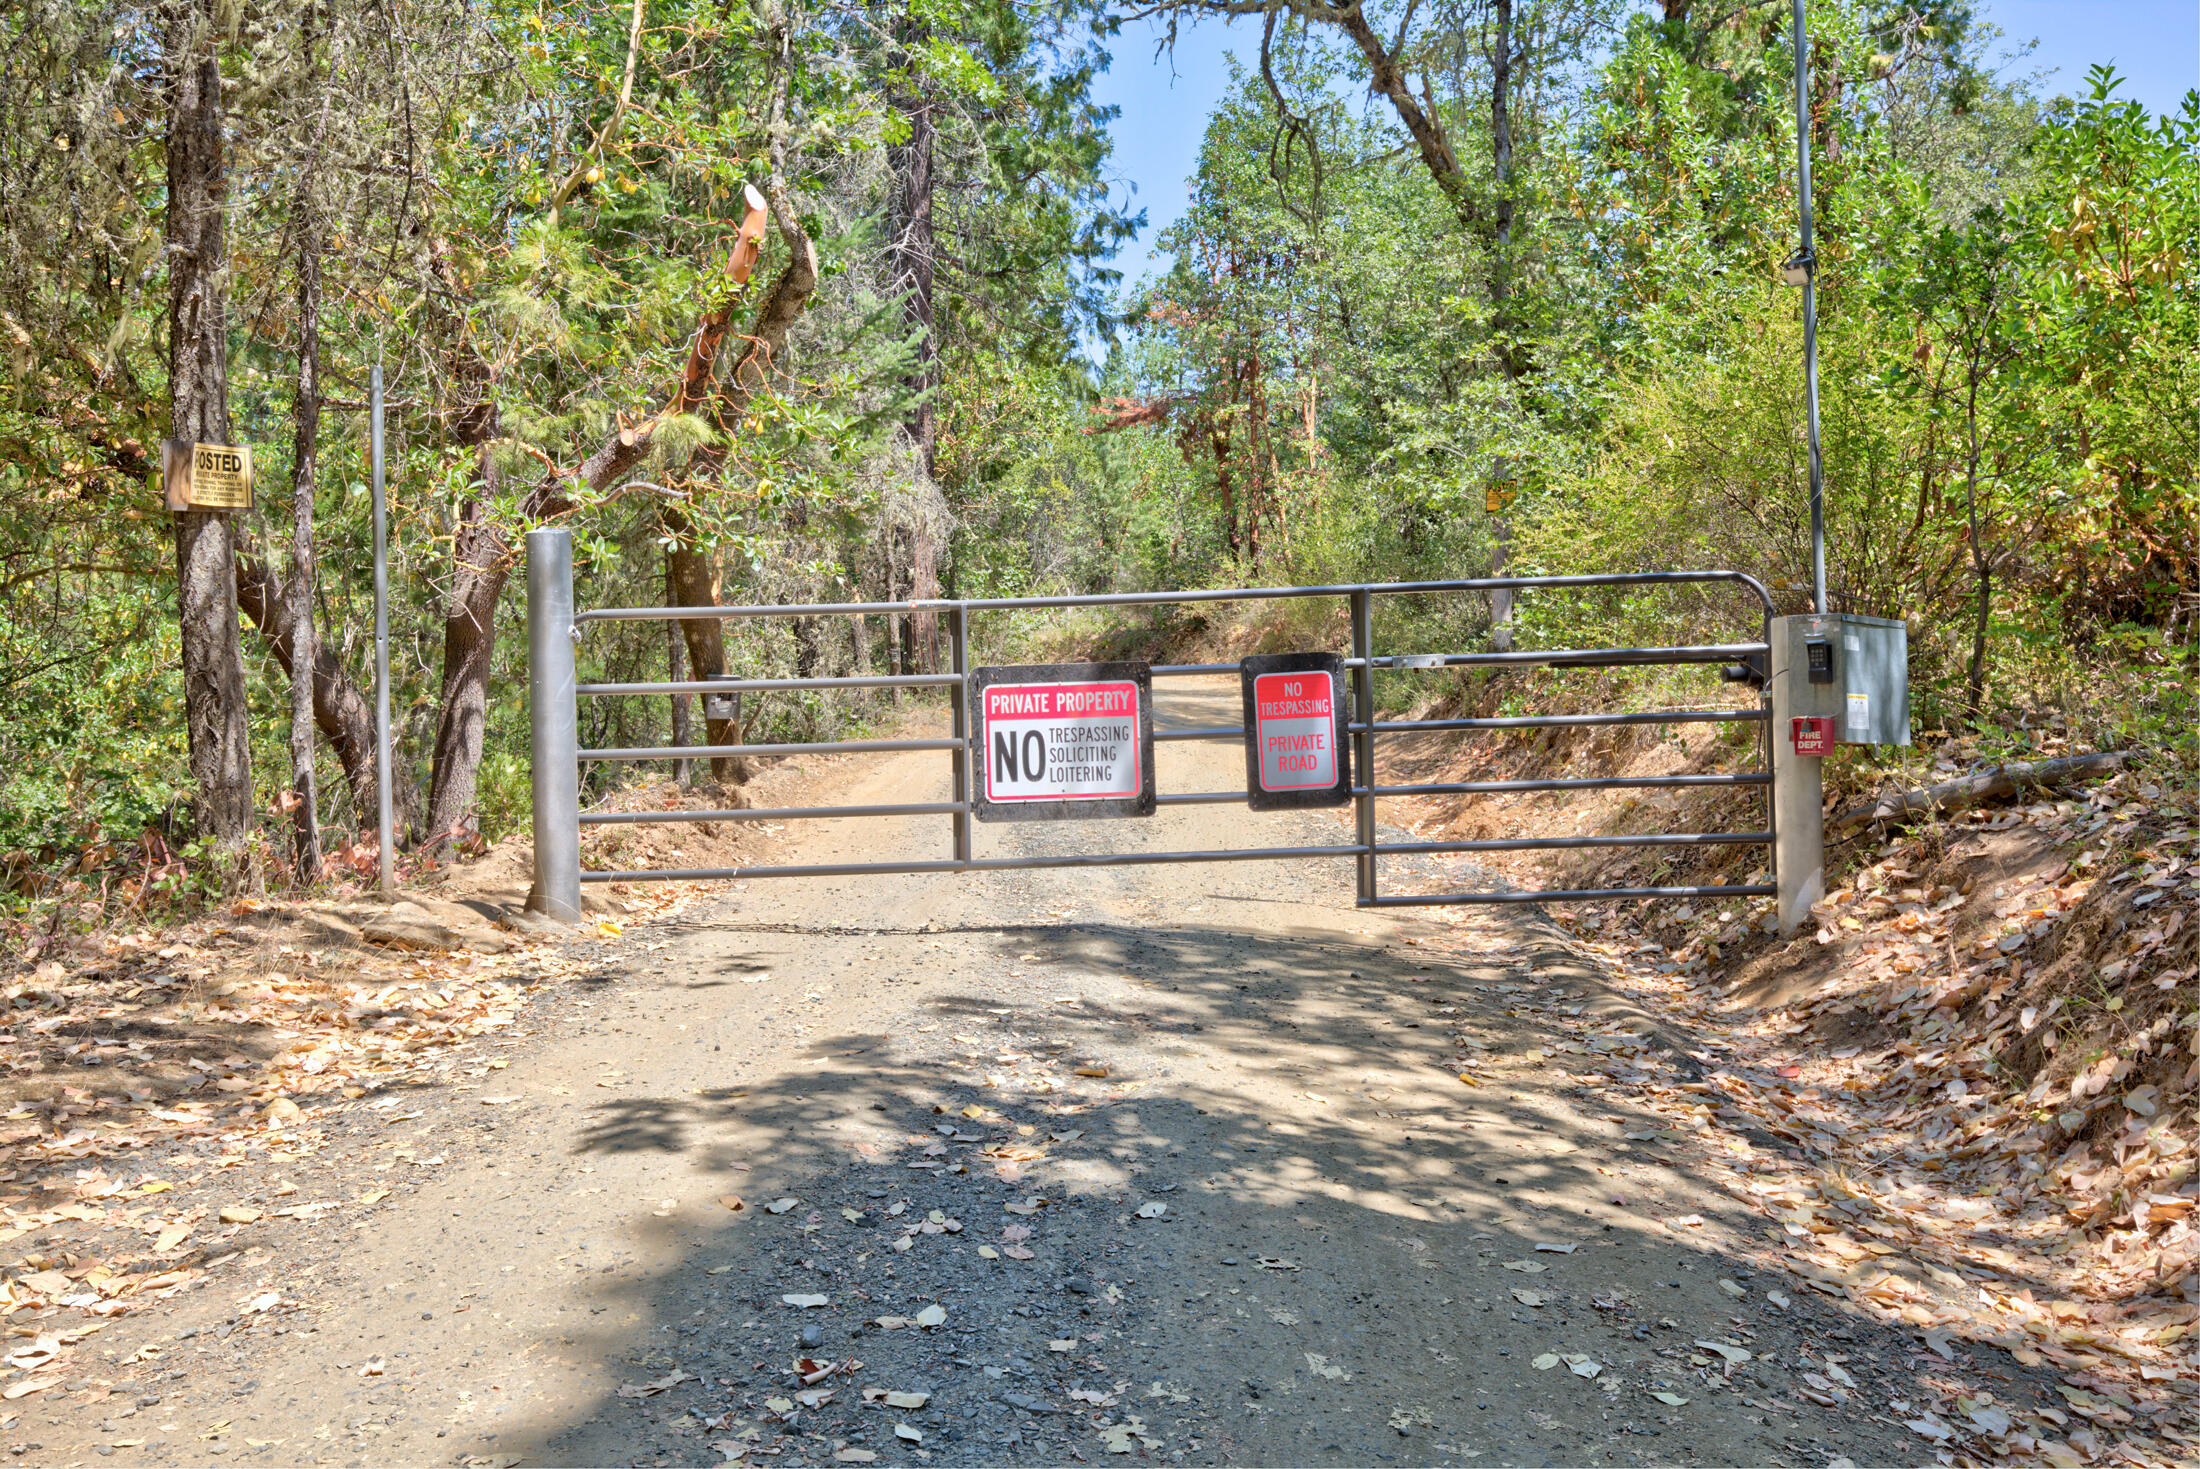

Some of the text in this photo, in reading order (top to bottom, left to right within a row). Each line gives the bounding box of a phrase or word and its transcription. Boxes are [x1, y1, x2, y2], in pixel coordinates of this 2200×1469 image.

[1284, 682, 1302, 697] NO
[991, 690, 1129, 714] PRIVATE PROPERTY
[1260, 698, 1329, 716] TRESPASSING
[1049, 726, 1129, 743] TRESPASSING
[1268, 733, 1325, 752] PRIVATE
[1799, 731, 1821, 739] FIRE
[1797, 740, 1824, 749] DEPT.
[994, 730, 1046, 783] NO
[1049, 746, 1117, 763] SOLICITING
[1278, 754, 1317, 772] ROAD
[1050, 765, 1112, 783] LOITERING
